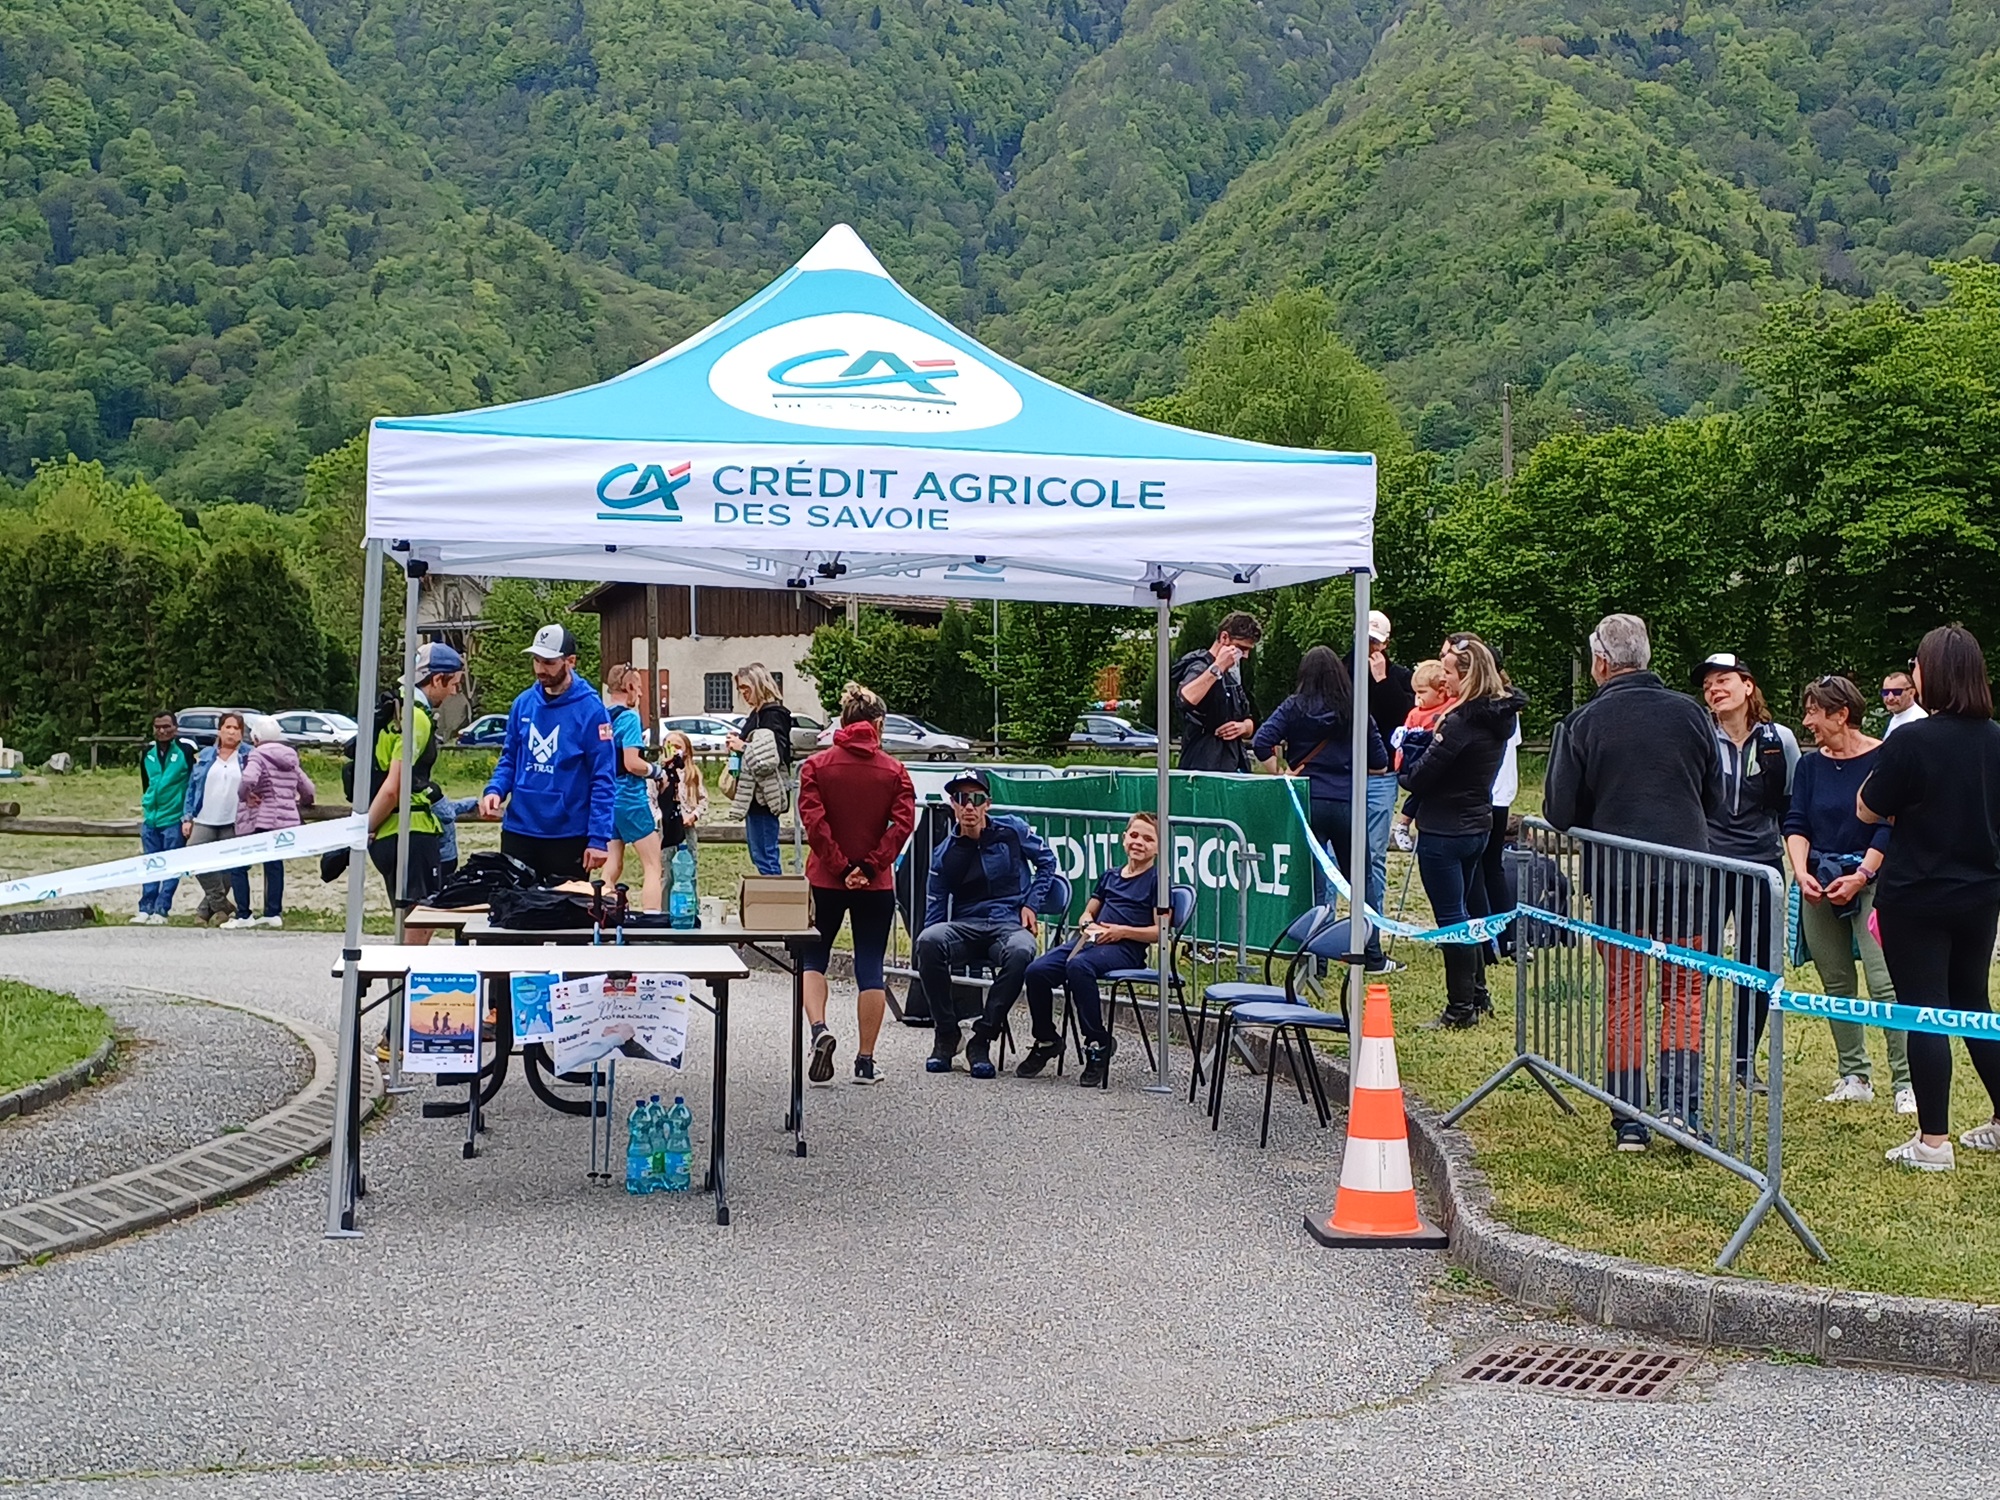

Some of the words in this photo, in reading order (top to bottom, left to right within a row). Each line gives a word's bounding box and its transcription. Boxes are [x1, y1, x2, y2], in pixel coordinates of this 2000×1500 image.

[713, 460, 898, 498] CRÉDIT
[913, 472, 1166, 510] AGRICOLE
[715, 502, 791, 526] DES
[807, 505, 949, 530] SAVOIE
